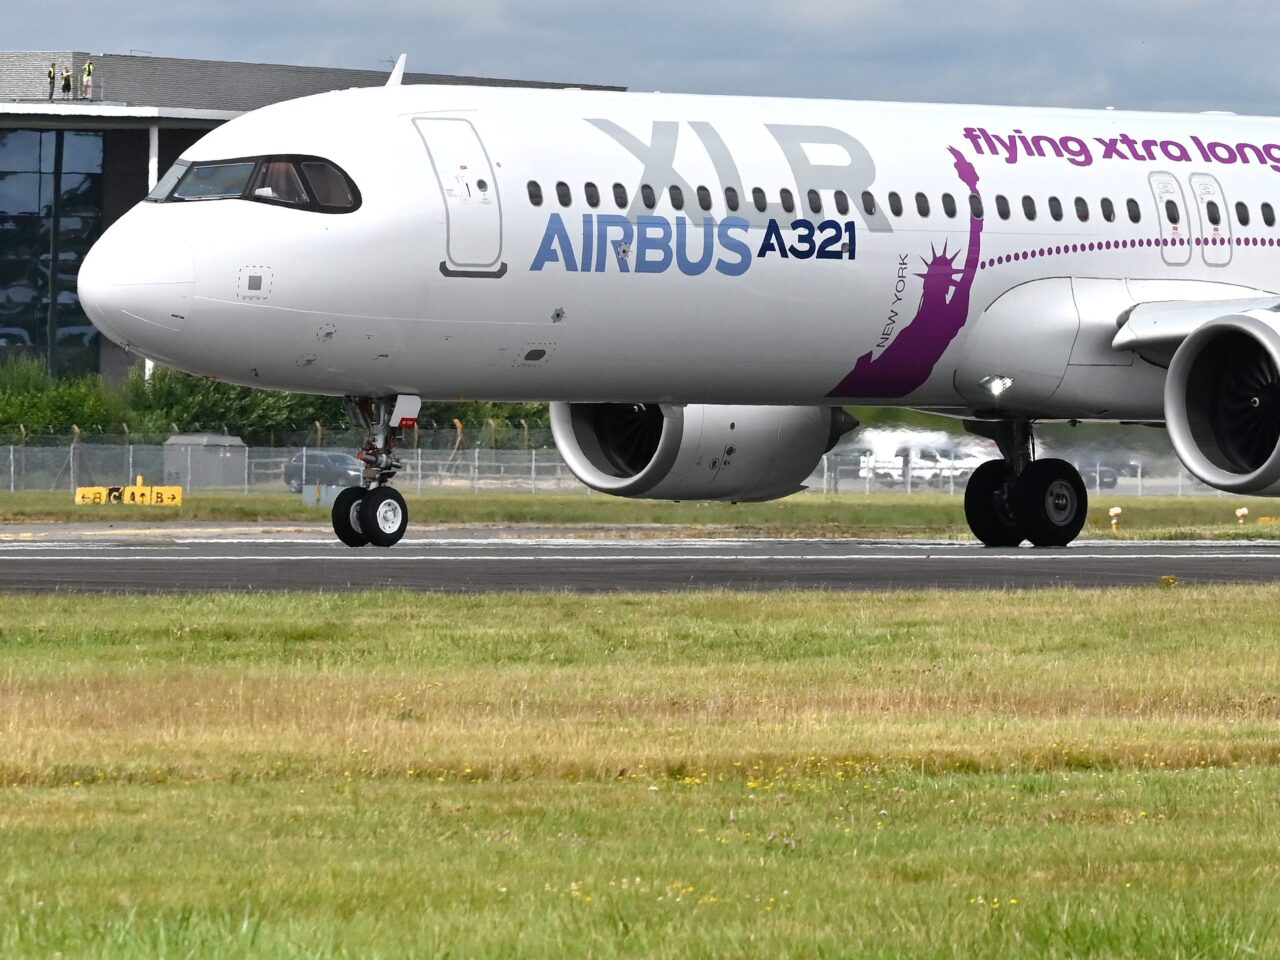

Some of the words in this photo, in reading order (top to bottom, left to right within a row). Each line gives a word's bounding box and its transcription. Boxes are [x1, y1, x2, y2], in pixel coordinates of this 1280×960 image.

[583, 118, 893, 233] XLR
[964, 127, 1093, 167] flying
[1094, 134, 1191, 163] xtra
[529, 213, 752, 276] AIRBUS
[757, 218, 857, 260] A321
[876, 309, 899, 348] NEW
[891, 253, 909, 305] YORK
[156, 492, 164, 503] B
